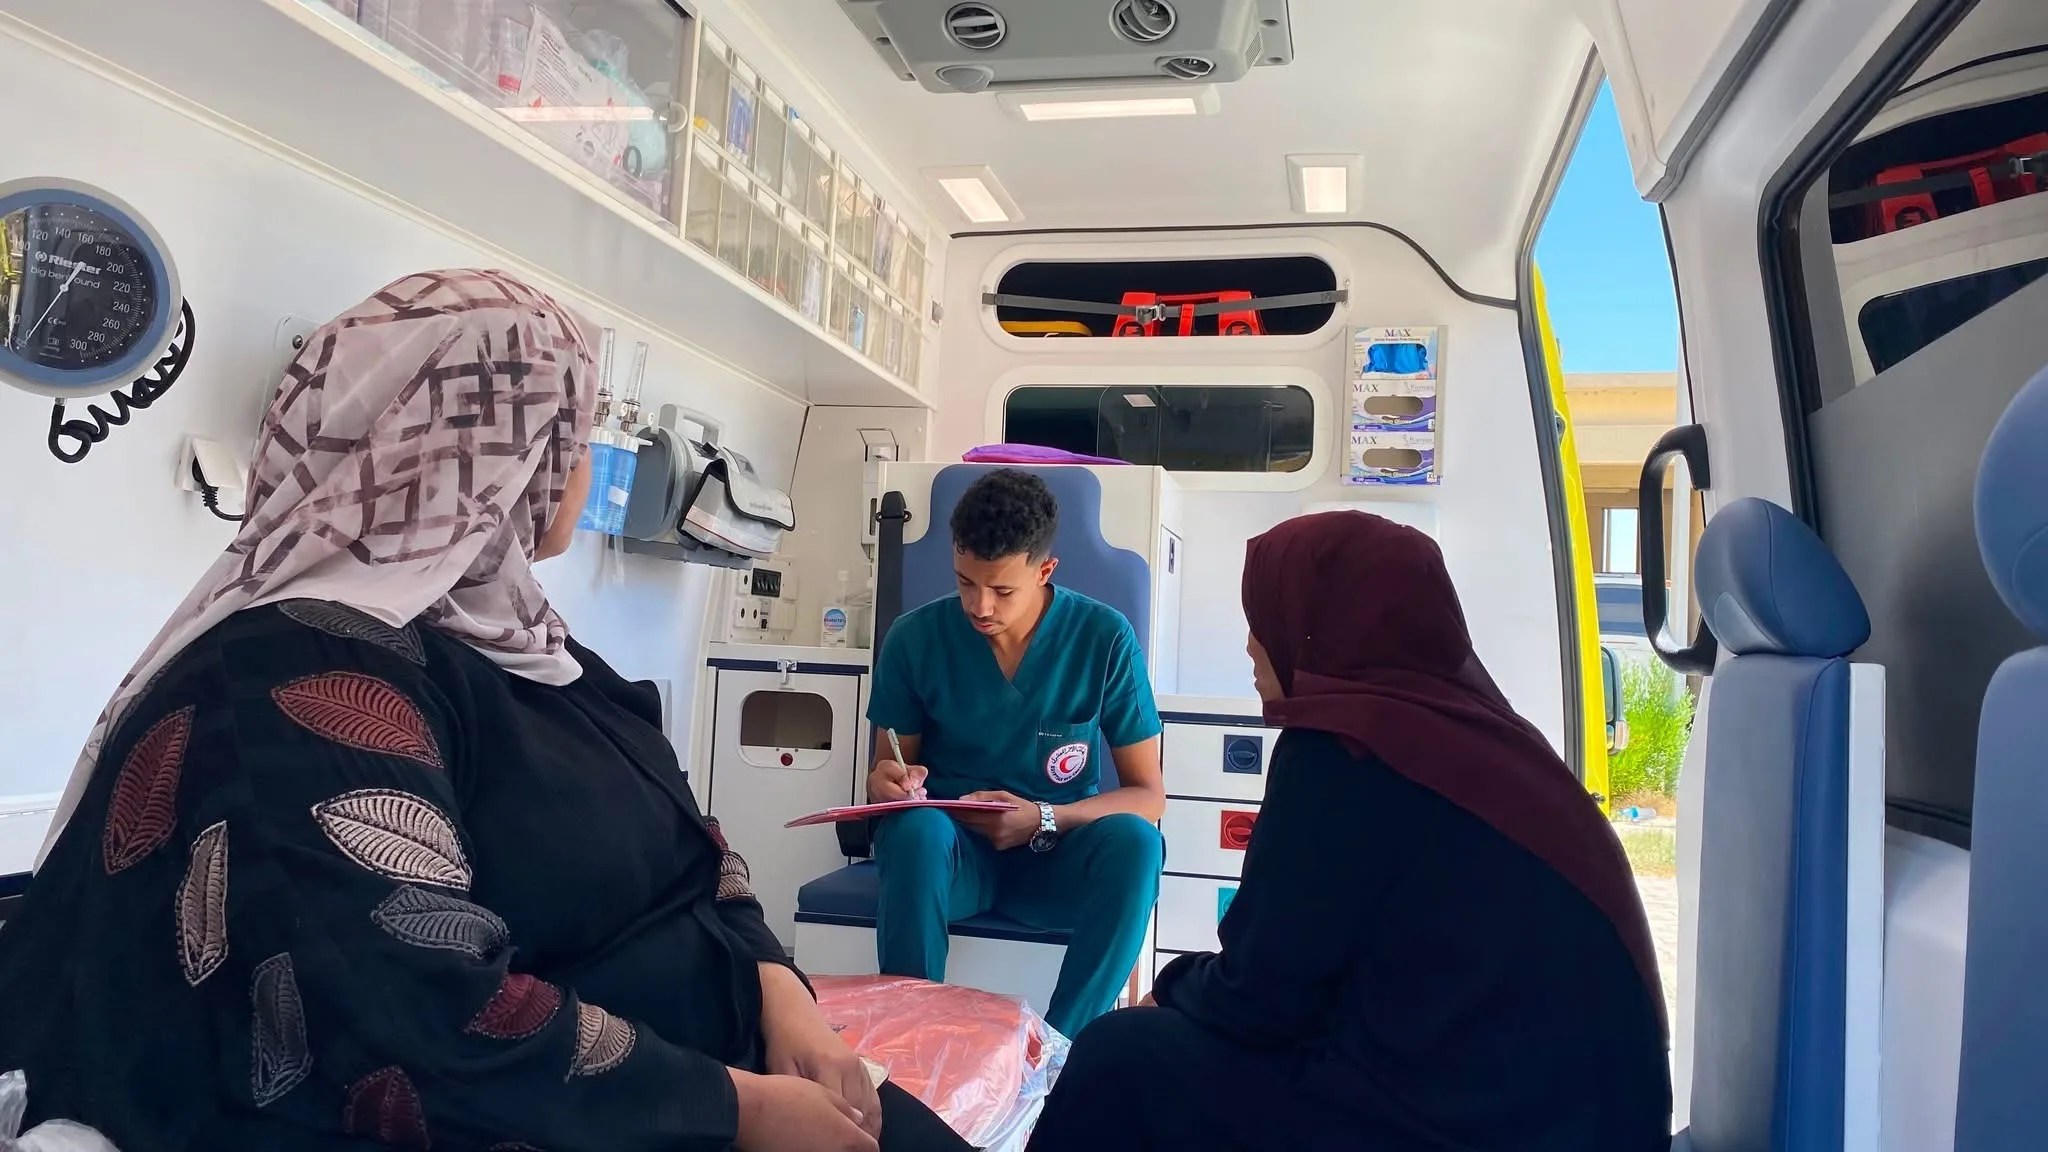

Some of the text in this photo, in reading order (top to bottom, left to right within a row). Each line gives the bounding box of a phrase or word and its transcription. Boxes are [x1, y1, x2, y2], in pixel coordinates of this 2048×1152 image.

[32, 229, 48, 241] 120
[55, 227, 71, 239] 140
[78, 232, 94, 244] 160
[95, 245, 111, 257] 180
[106, 262, 124, 274] 200
[31, 266, 46, 278] big
[71, 277, 100, 289] ound
[112, 281, 131, 293] 220
[112, 301, 130, 314] 240
[102, 317, 120, 330] 260
[87, 330, 105, 343] 280
[1384, 329, 1411, 337] MAX
[69, 338, 87, 351] 300
[1353, 384, 1379, 393] MAX
[1352, 436, 1377, 445] MAX
